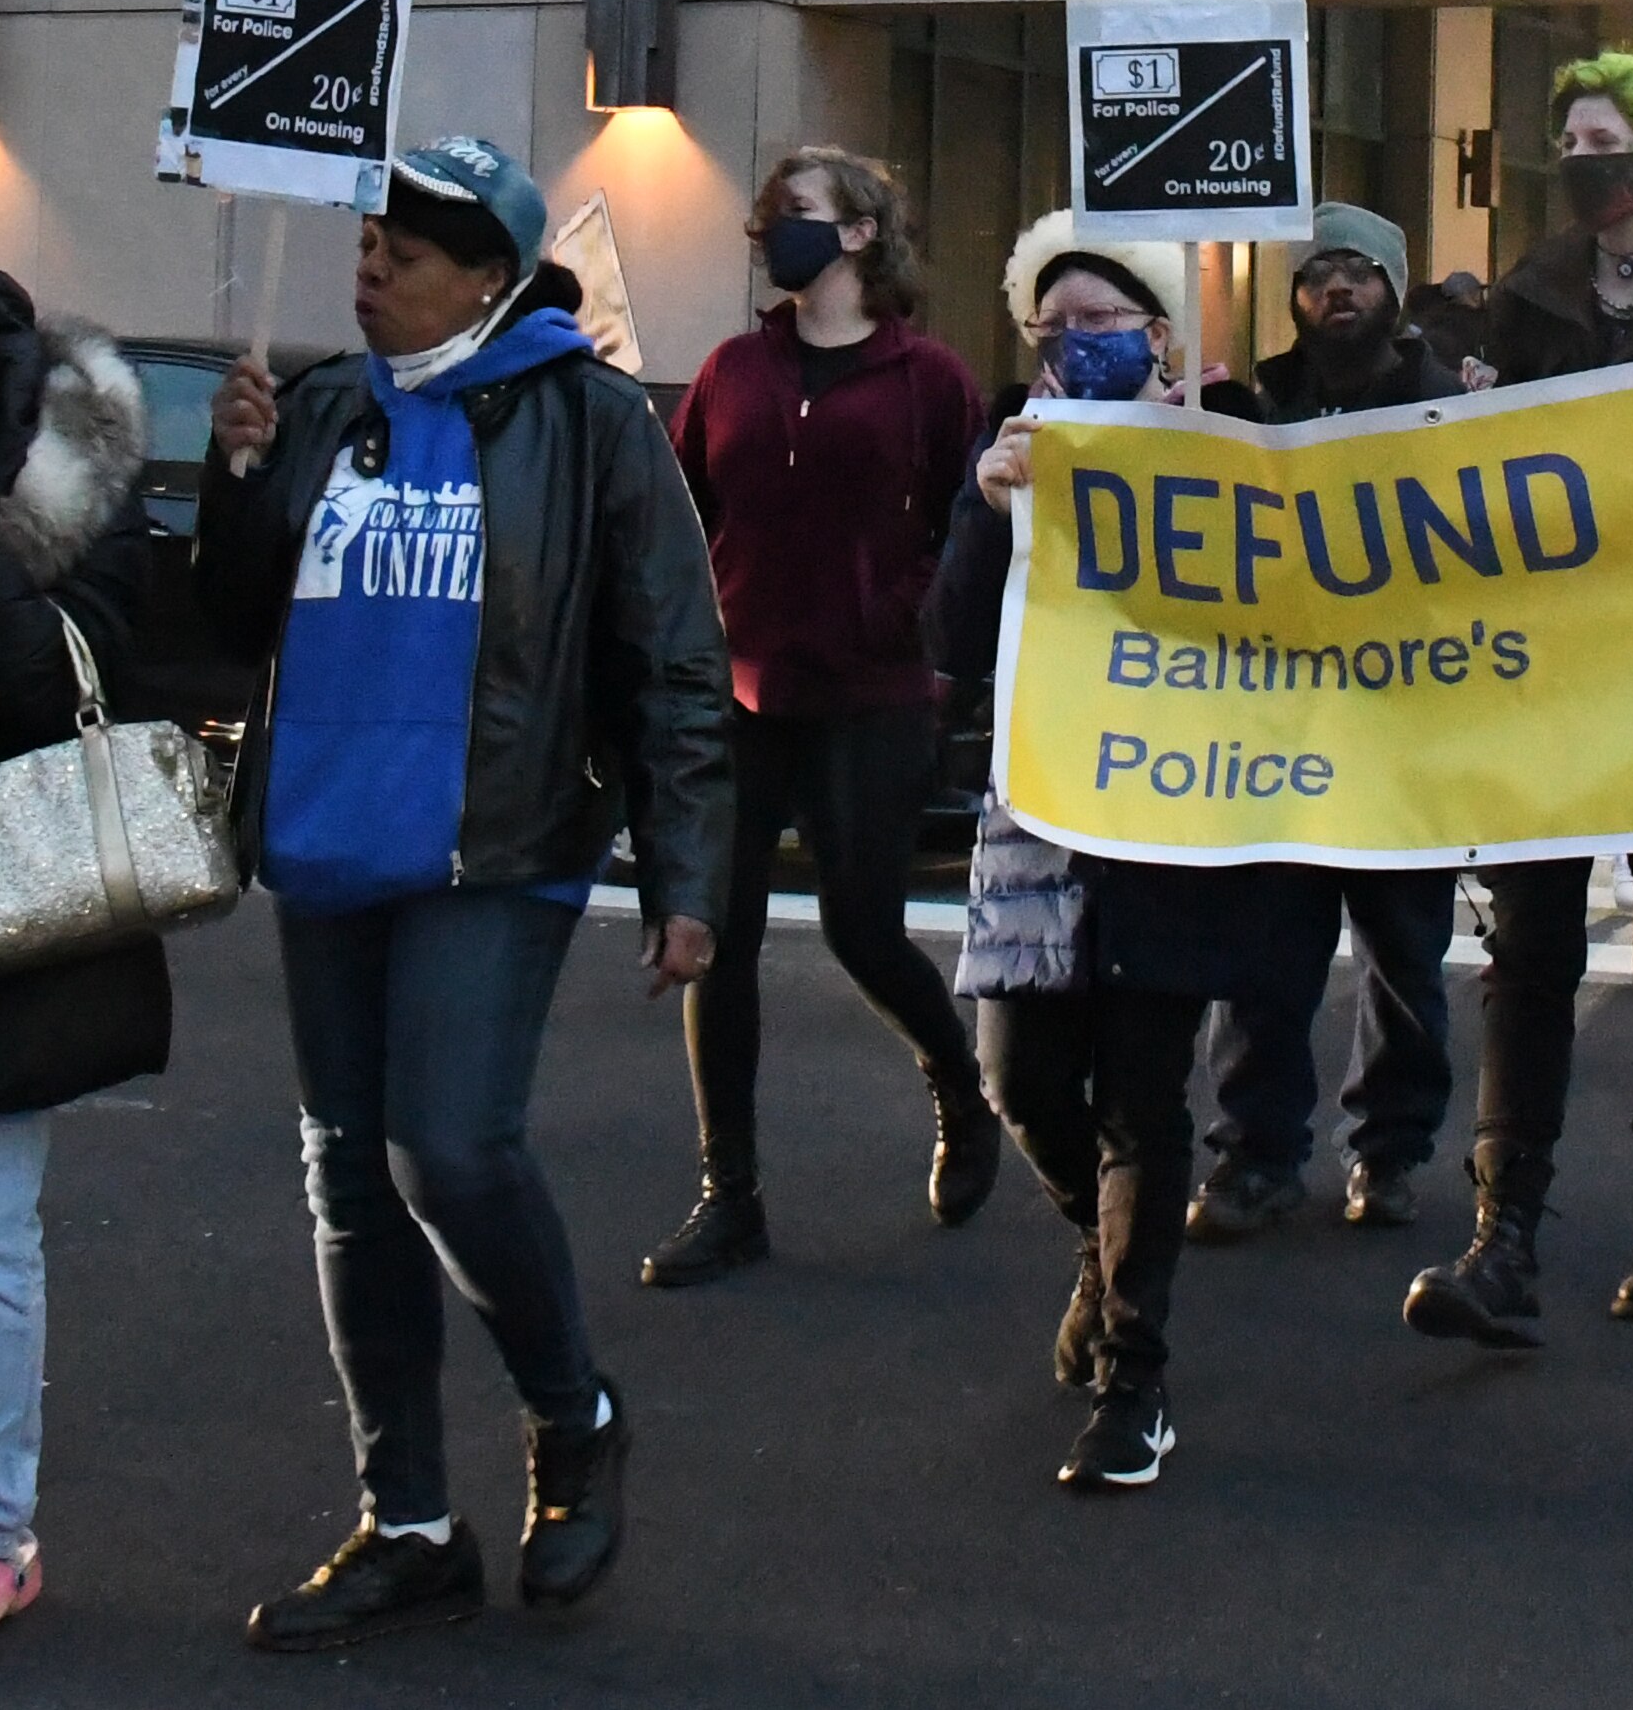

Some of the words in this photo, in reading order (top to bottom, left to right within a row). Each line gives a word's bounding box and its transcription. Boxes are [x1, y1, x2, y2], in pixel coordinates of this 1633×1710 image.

[213, 14, 239, 34] For
[242, 17, 294, 40] Police
[204, 81, 223, 101] for
[221, 64, 249, 92] every
[1127, 58, 1163, 90] $1
[1092, 102, 1121, 118] For
[1125, 101, 1180, 117] Police
[265, 112, 291, 133] On
[294, 116, 365, 144] Housing
[1094, 163, 1112, 180] for
[1110, 142, 1139, 167] every
[1165, 179, 1191, 195] On
[1195, 177, 1272, 197] Housing
[1071, 452, 1601, 605] DEFUND
[1107, 620, 1532, 692] Baltimore's
[1094, 732, 1335, 800] Police
